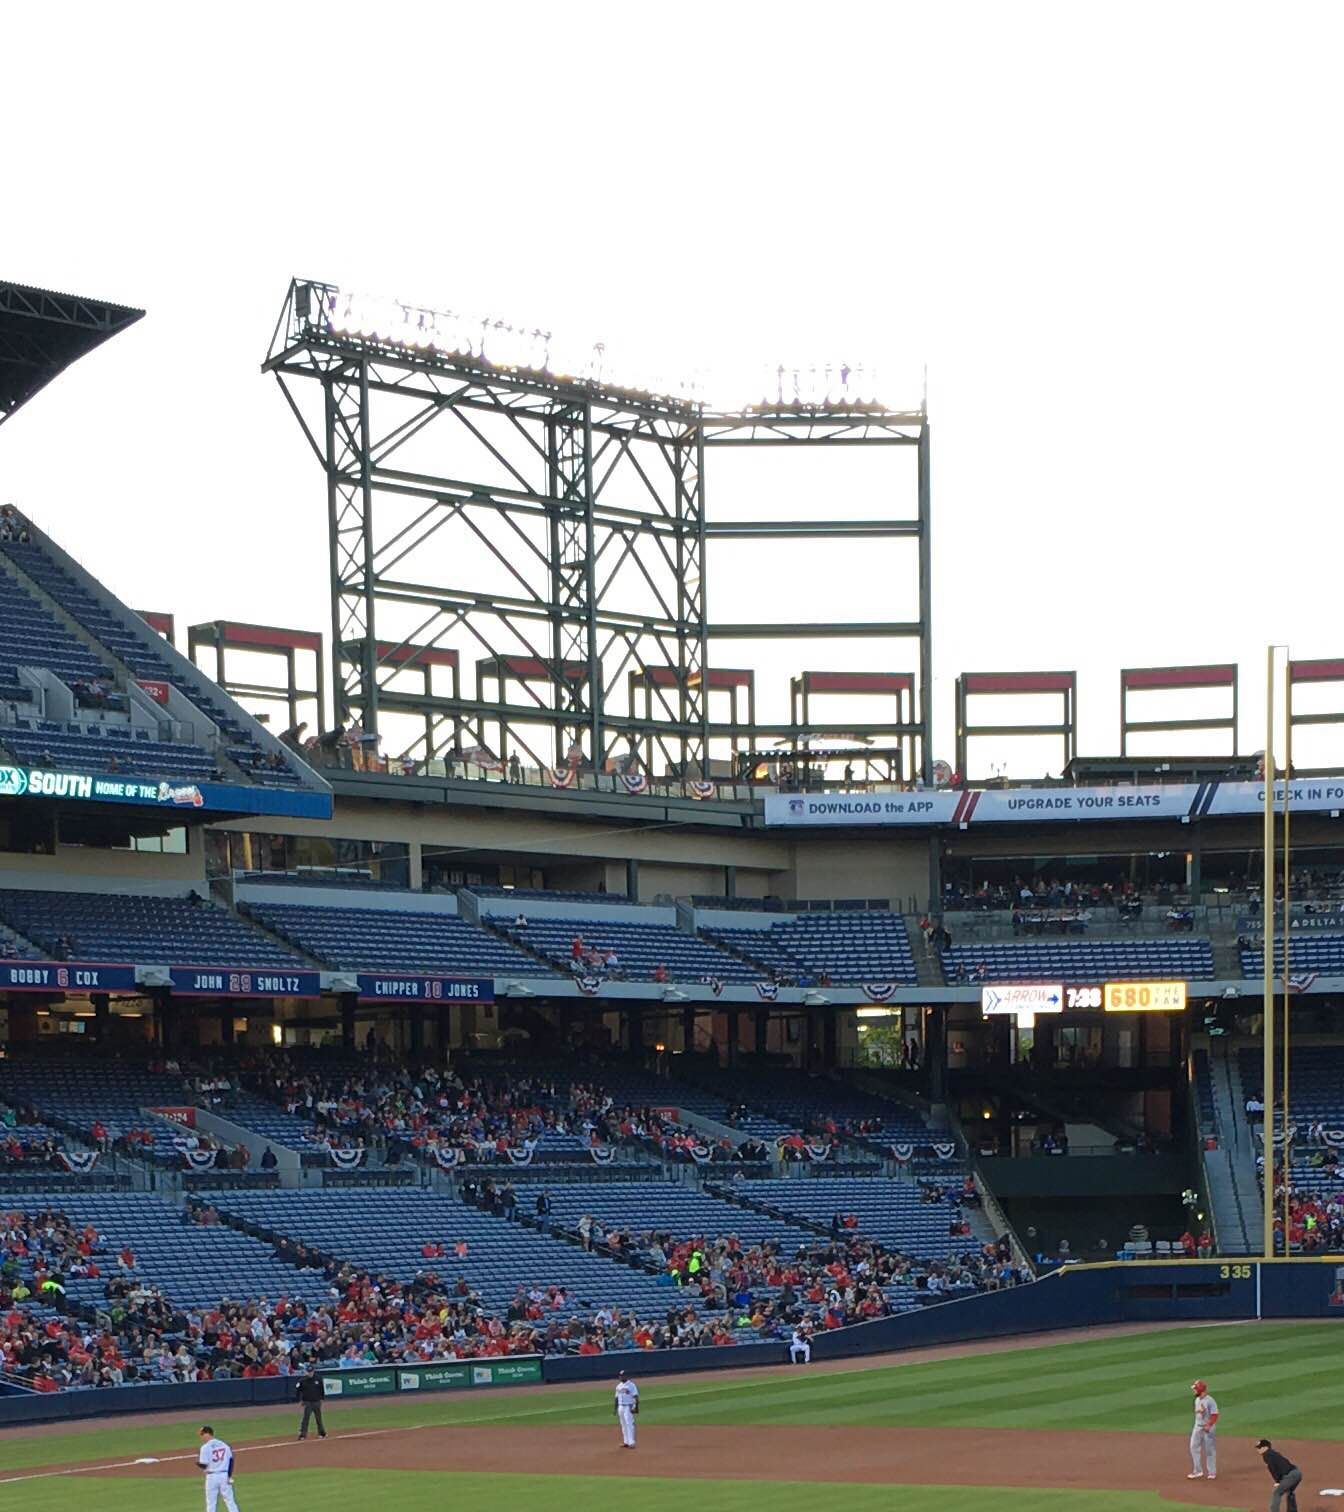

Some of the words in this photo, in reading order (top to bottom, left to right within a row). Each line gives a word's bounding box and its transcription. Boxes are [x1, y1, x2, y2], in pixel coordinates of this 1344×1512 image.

[28, 770, 93, 798] SOUTH
[95, 781, 124, 796] HOME
[125, 783, 139, 797] OF
[139, 784, 157, 799] THE
[1308, 786, 1322, 800] IN
[809, 801, 882, 814] DOWNLOAD
[885, 802, 904, 813] the
[906, 801, 933, 813] APP
[1007, 796, 1072, 810] UPGRADE
[1076, 796, 1114, 809] YOUR
[1117, 795, 1161, 807] SEATS
[1302, 917, 1336, 928] DELTA
[10, 968, 49, 985] BOBBY
[56, 968, 69, 987] 6
[76, 969, 100, 986] COX
[193, 973, 223, 990] JOHN
[228, 973, 252, 992] 29
[257, 975, 300, 992] SMOLTZ
[375, 979, 419, 996] CHIPPER
[424, 981, 443, 998] 10
[447, 982, 479, 998] JONES
[1004, 989, 1047, 1002] ARROW
[1111, 987, 1151, 1007] 680
[1220, 1264, 1252, 1279] 335
